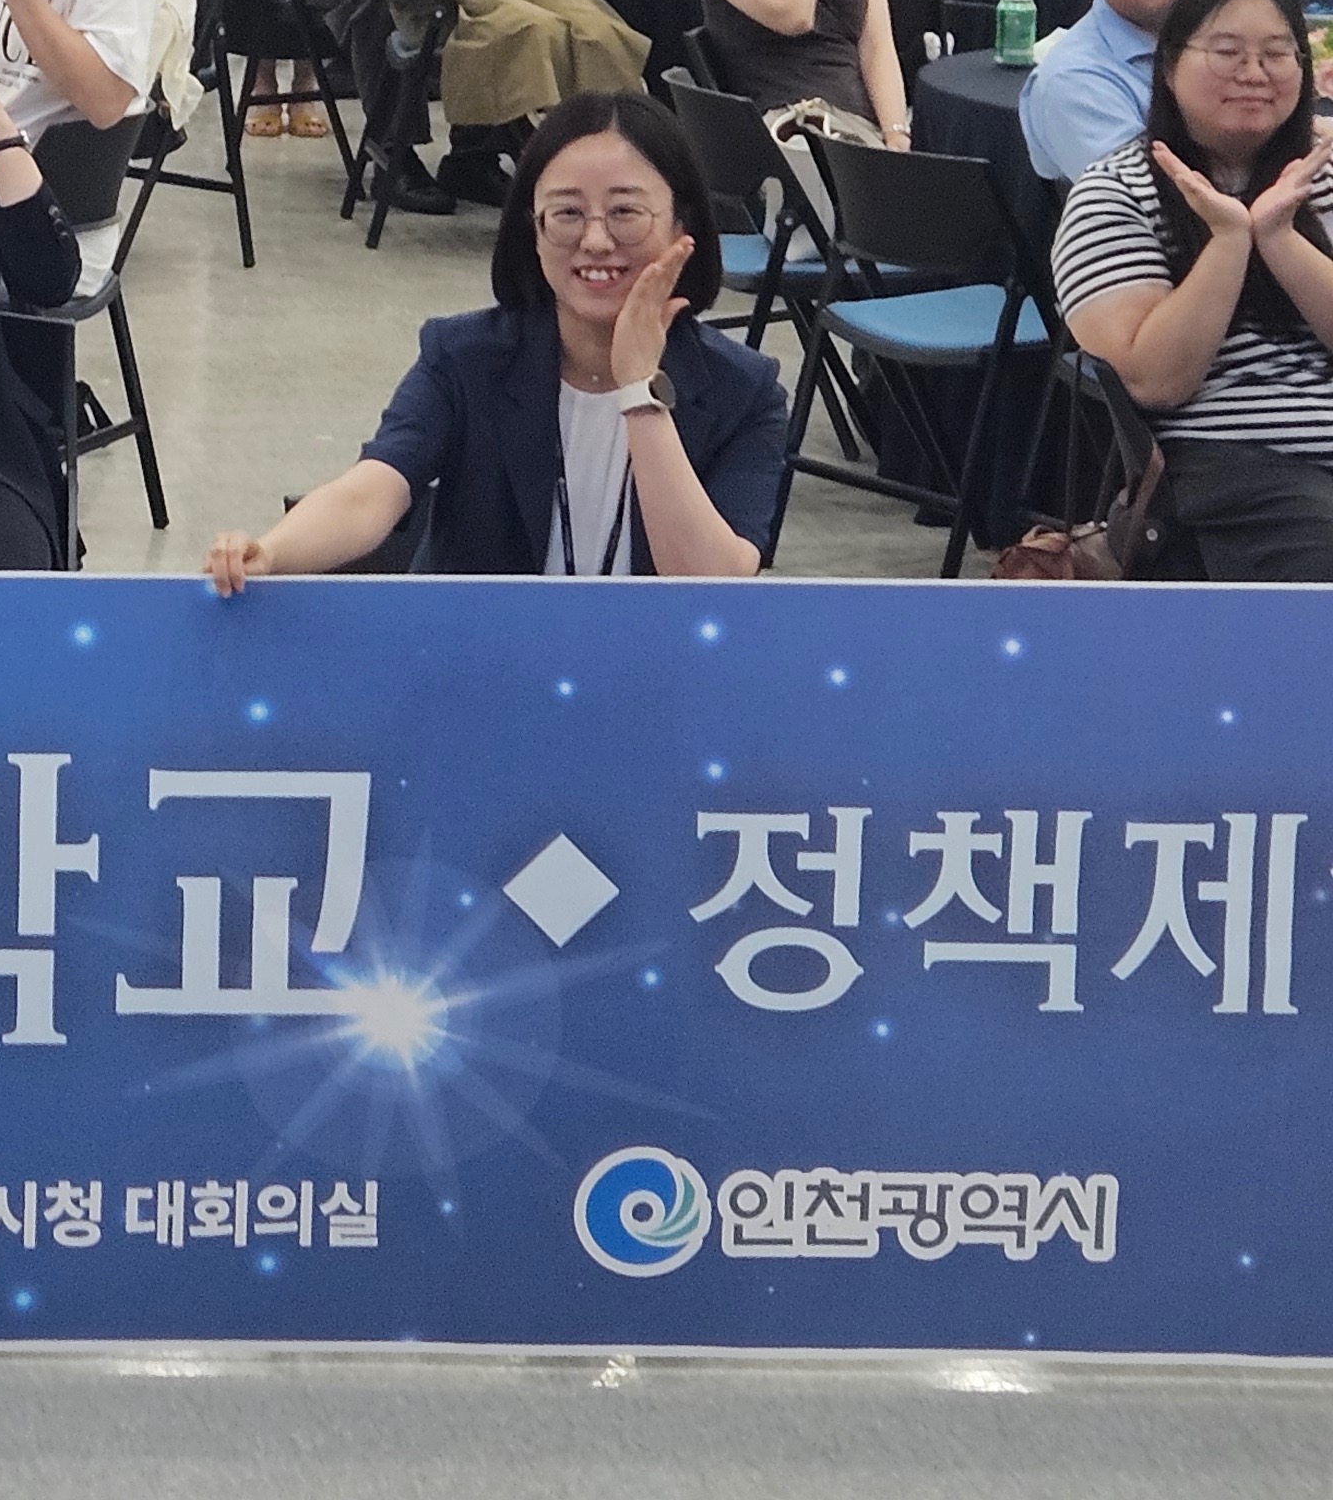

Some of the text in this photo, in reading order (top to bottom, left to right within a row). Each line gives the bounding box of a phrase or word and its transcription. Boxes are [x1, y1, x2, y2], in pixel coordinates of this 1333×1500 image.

[688, 806, 1333, 1015] 정책제
[124, 1180, 379, 1250] 대회의실
[732, 1178, 1107, 1251] 인천광역시
